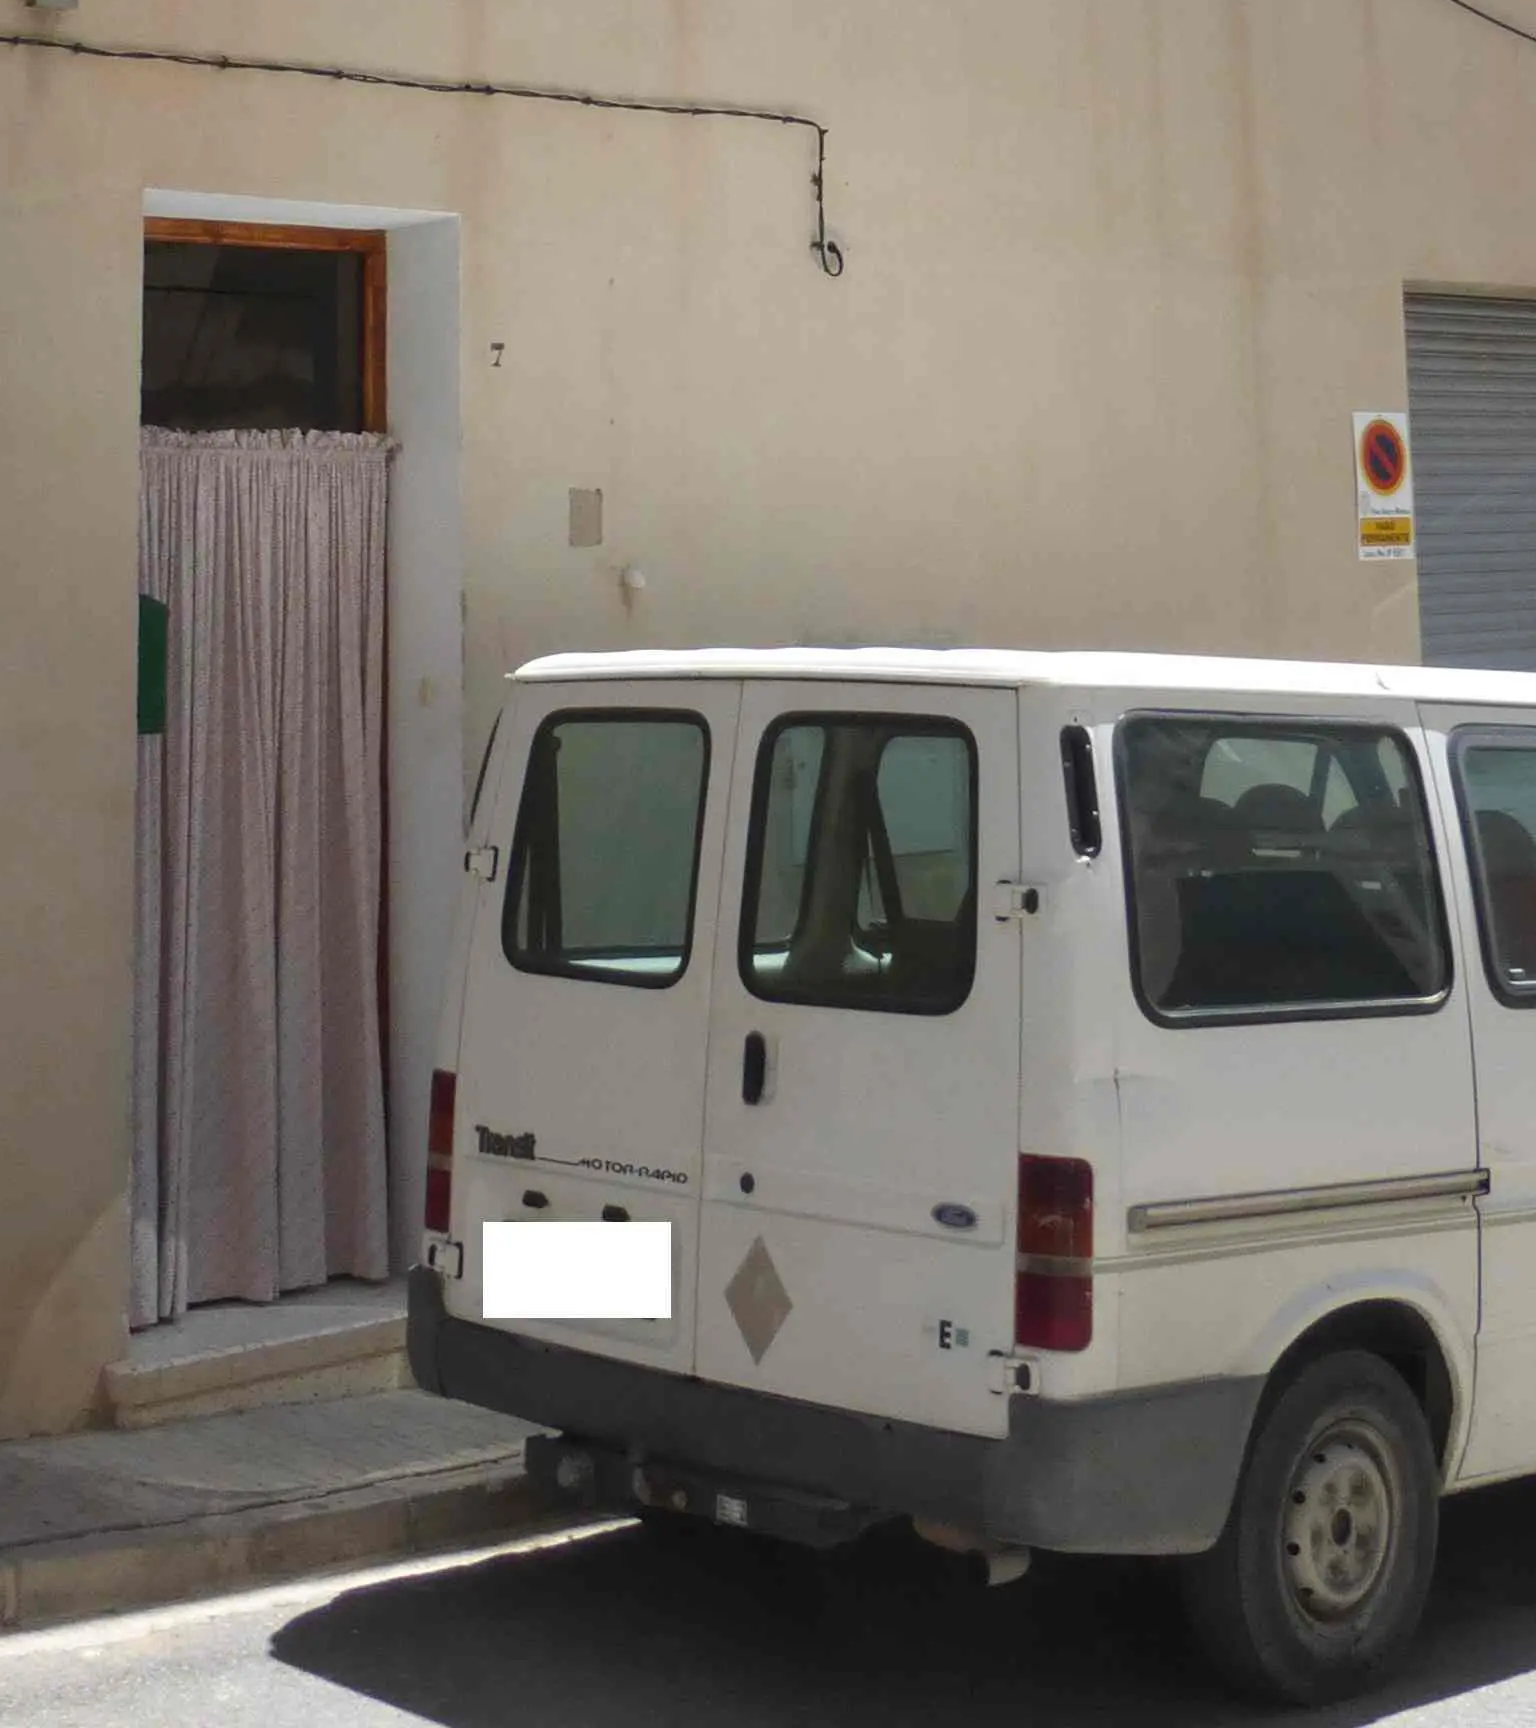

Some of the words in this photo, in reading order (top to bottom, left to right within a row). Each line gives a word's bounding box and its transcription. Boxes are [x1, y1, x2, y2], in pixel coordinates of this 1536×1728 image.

[490, 341, 505, 368] 7
[475, 1124, 537, 1161] Transit
[939, 1319, 953, 1350] E
